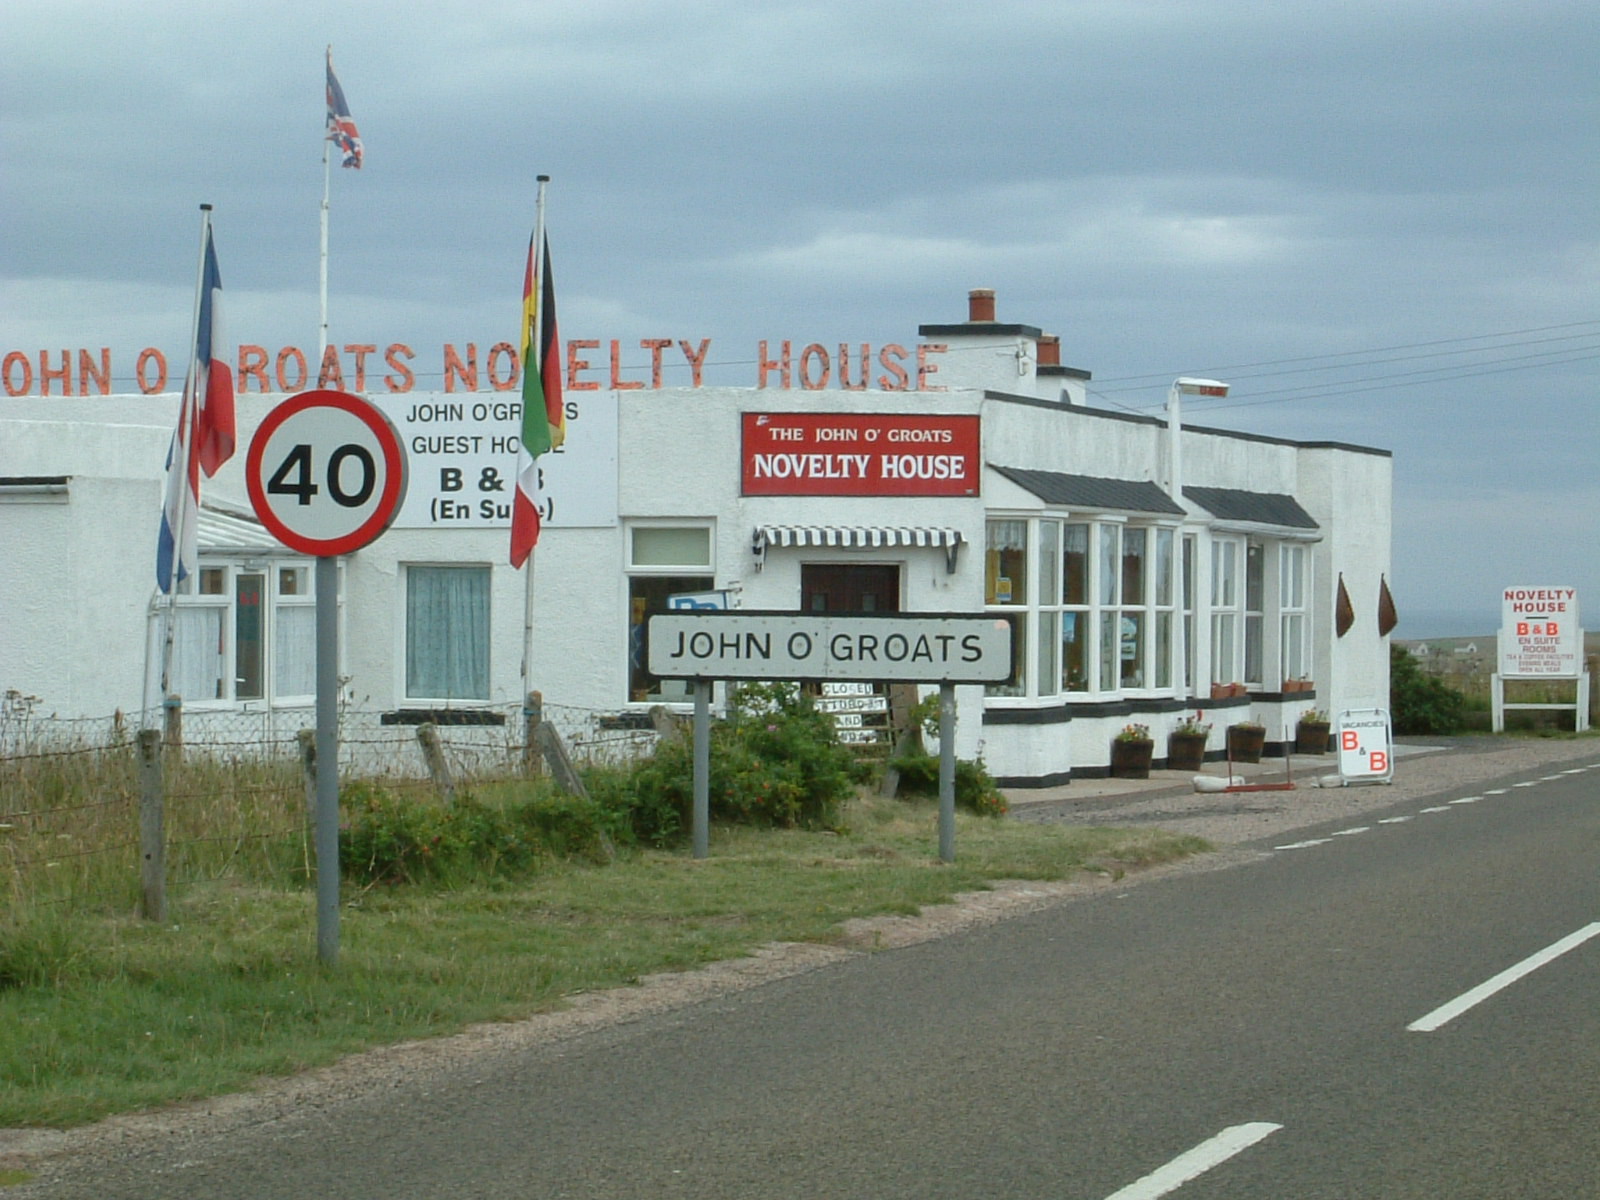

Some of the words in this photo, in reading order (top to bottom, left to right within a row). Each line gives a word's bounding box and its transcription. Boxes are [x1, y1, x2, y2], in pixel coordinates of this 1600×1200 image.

[238, 343, 415, 393] ROATS
[443, 338, 711, 393] NOELTY
[758, 339, 948, 391] HOUSE
[406, 403, 463, 422] JOHN
[472, 402, 579, 422] O'GRS
[769, 427, 803, 441] THE
[815, 428, 858, 442] JOHN
[864, 428, 881, 442] O'
[887, 429, 953, 443] GROATS
[412, 436, 483, 454] GUEST
[753, 453, 871, 479] NOVELTY
[881, 454, 966, 479] HOUSE
[267, 444, 376, 508] 40
[440, 467, 463, 492] B
[478, 466, 505, 492] &
[431, 497, 470, 522] (En
[1504, 589, 1575, 601] NOVELTY
[1513, 602, 1566, 613] HOUSE
[1517, 622, 1529, 636] B
[1532, 624, 1542, 635] &
[1546, 622, 1558, 636] B
[671, 631, 771, 660] JOHN
[787, 631, 819, 660] O'
[830, 633, 983, 663] GROATS
[1518, 637, 1531, 645] EN
[1533, 637, 1560, 645] SUITE
[1522, 645, 1556, 653] ROOMS
[822, 683, 872, 694] CLOSED
[1341, 720, 1385, 729] VACANCIES
[1342, 731, 1359, 751] B
[1370, 751, 1387, 771] B
